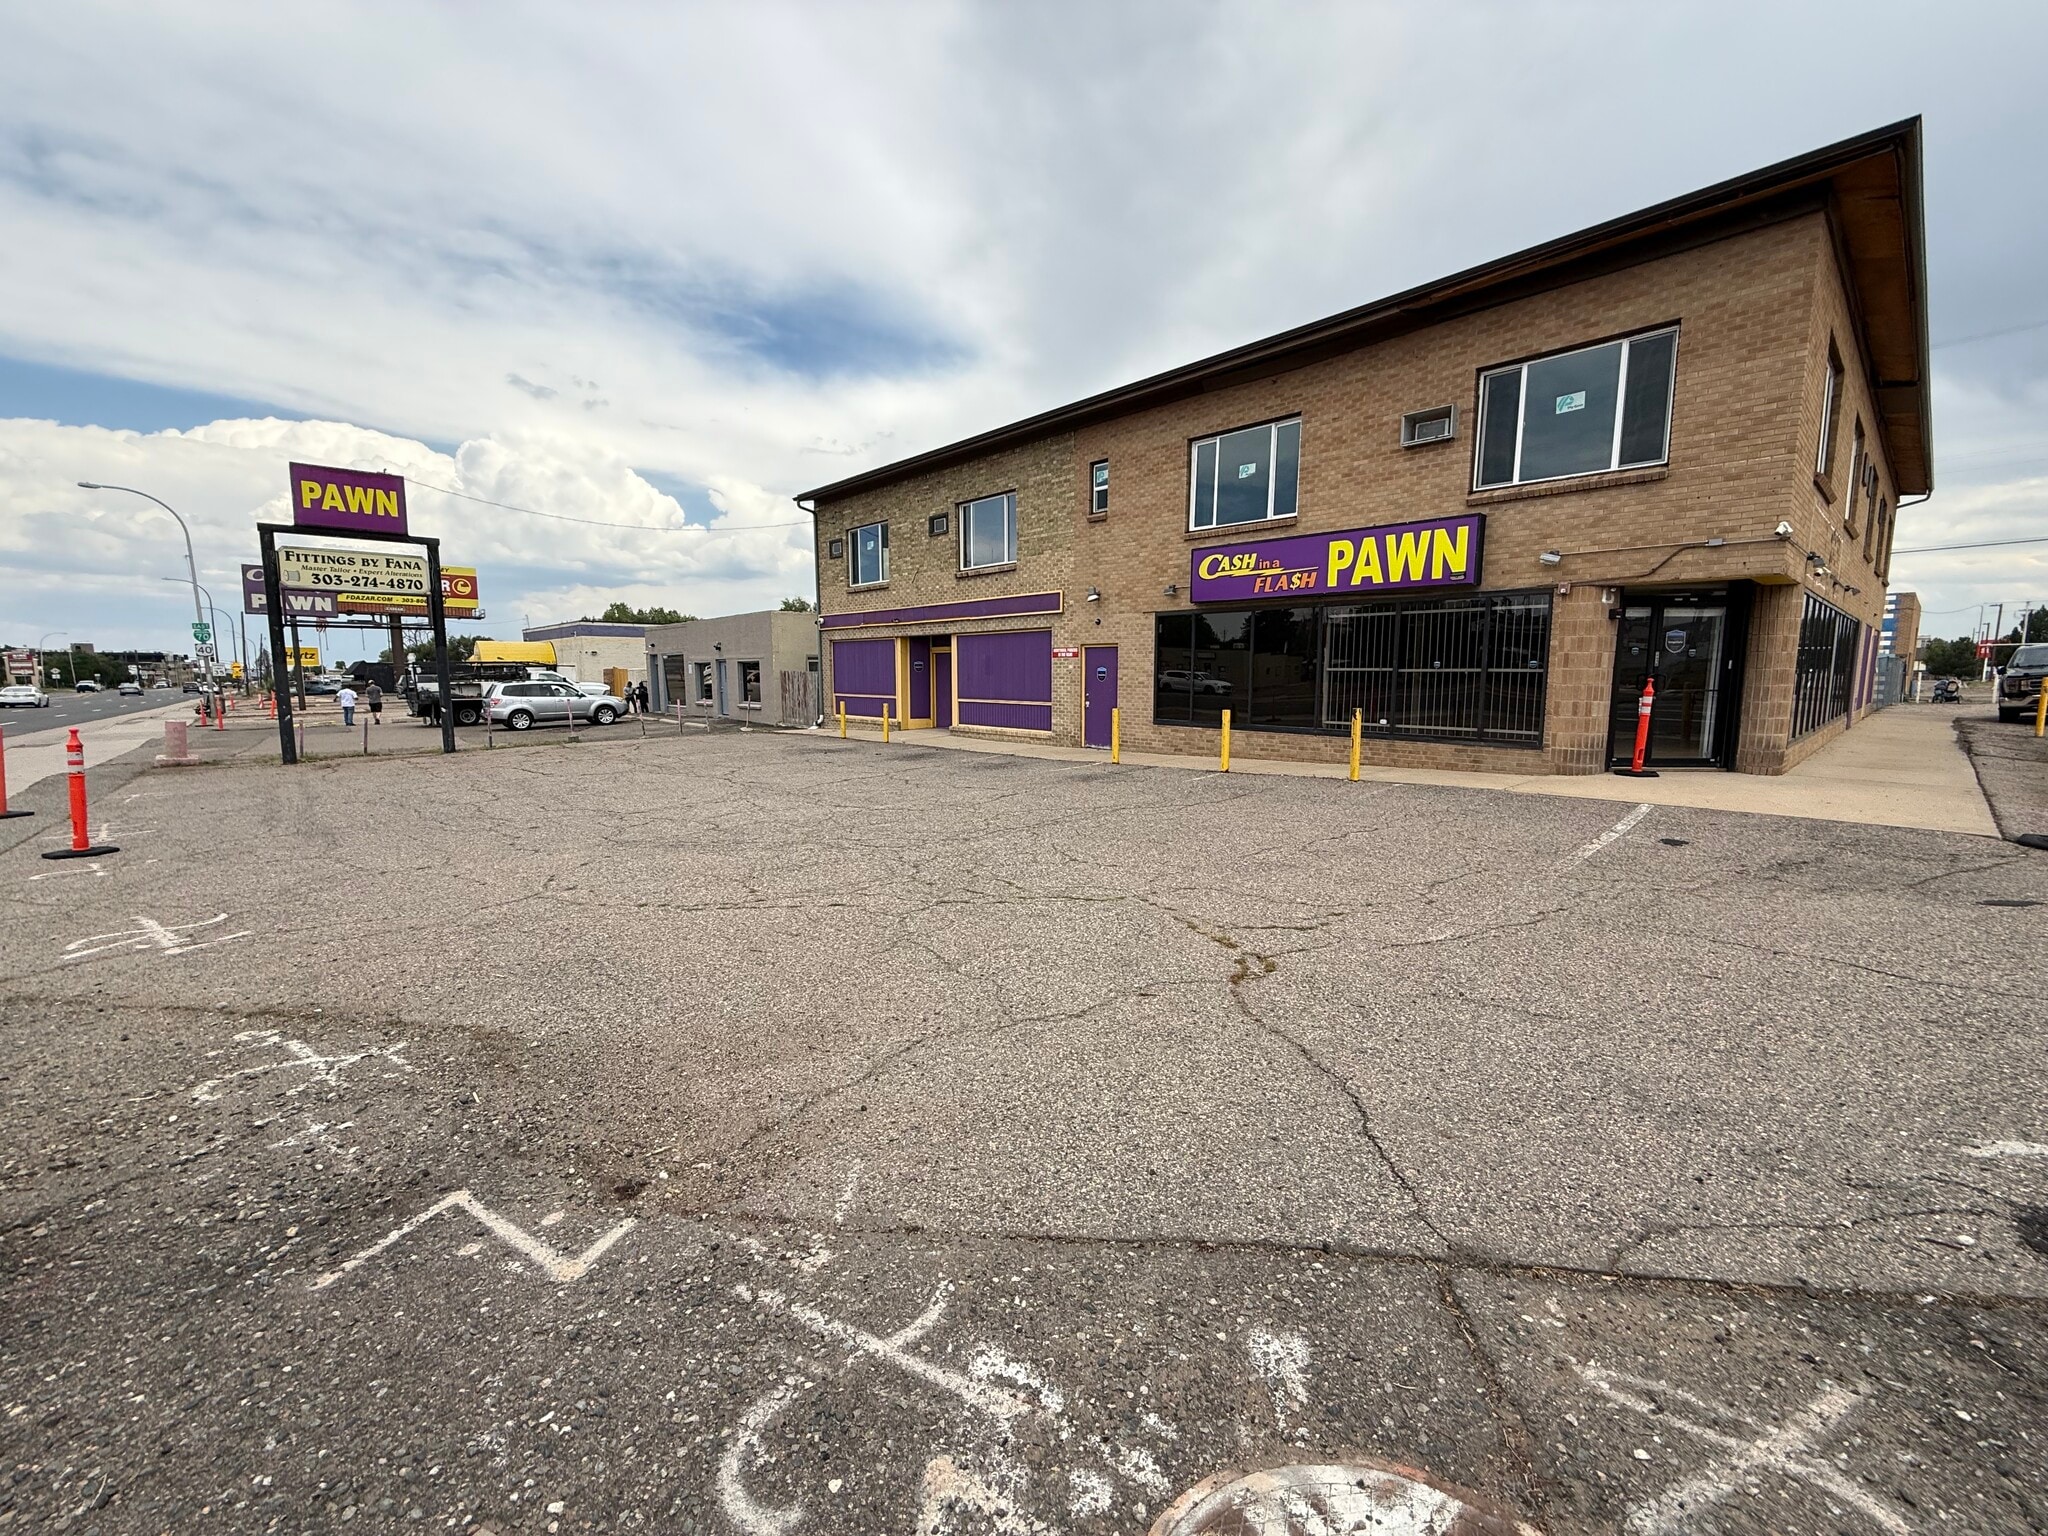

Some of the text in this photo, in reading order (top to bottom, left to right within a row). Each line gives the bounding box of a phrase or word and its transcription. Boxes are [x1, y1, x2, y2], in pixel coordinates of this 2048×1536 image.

[300, 480, 399, 517] PAWN
[284, 550, 422, 571] FITTINGS BY FANA
[1326, 525, 1468, 588] PAWN
[301, 564, 423, 578] Master Tailor Expert Alterations
[1198, 553, 1280, 580] CASH in a
[311, 573, 423, 590] 303-274-4870
[1253, 571, 1317, 594] FLA$H
[251, 593, 332, 612] PWN
[345, 594, 393, 602] FDAZAR.COM
[198, 646, 212, 654] 40
[285, 651, 316, 660] Hrtz
